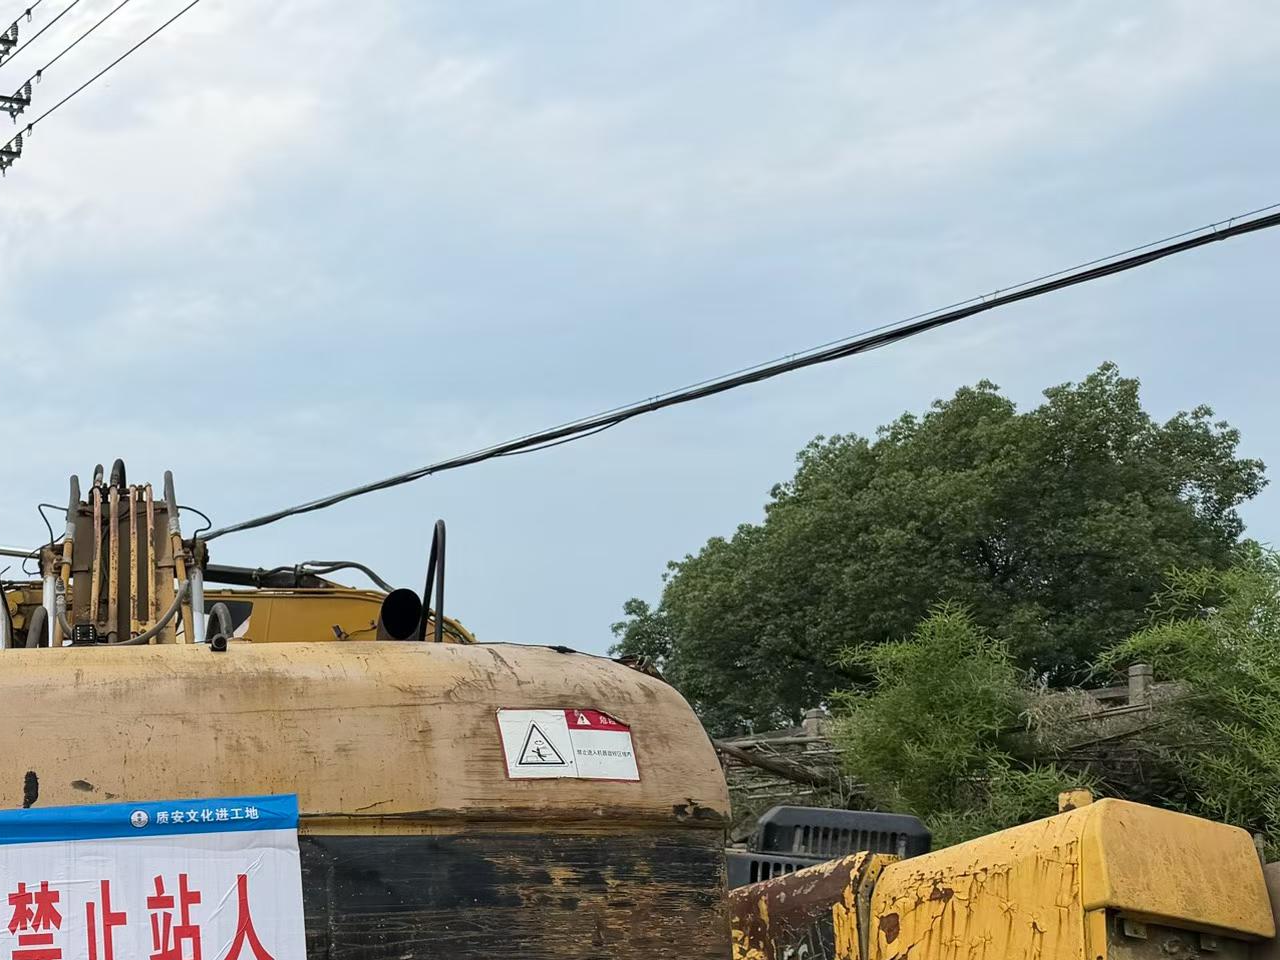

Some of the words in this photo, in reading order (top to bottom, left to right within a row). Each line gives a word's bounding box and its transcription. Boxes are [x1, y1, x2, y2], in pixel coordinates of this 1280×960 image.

[156, 805, 260, 825] 质安文化进工地
